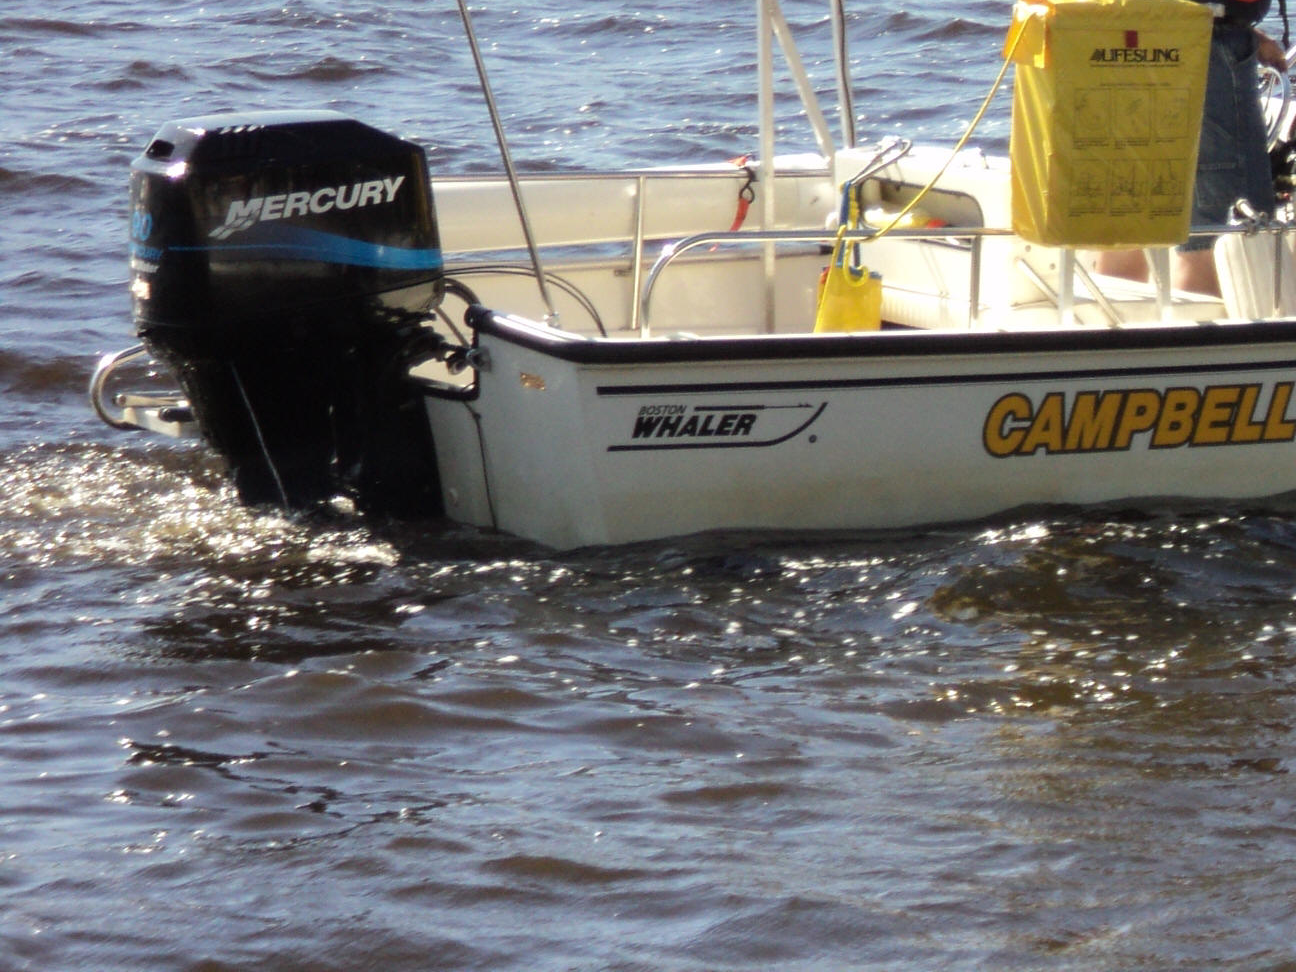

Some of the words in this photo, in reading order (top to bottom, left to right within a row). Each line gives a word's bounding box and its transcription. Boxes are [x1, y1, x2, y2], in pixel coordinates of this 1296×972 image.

[1101, 48, 1180, 63] LIFESLING
[208, 175, 406, 240] MERCURY
[638, 404, 687, 416] BOSTON
[982, 381, 1296, 458] CAMPBELL
[631, 414, 757, 439] WHALER
